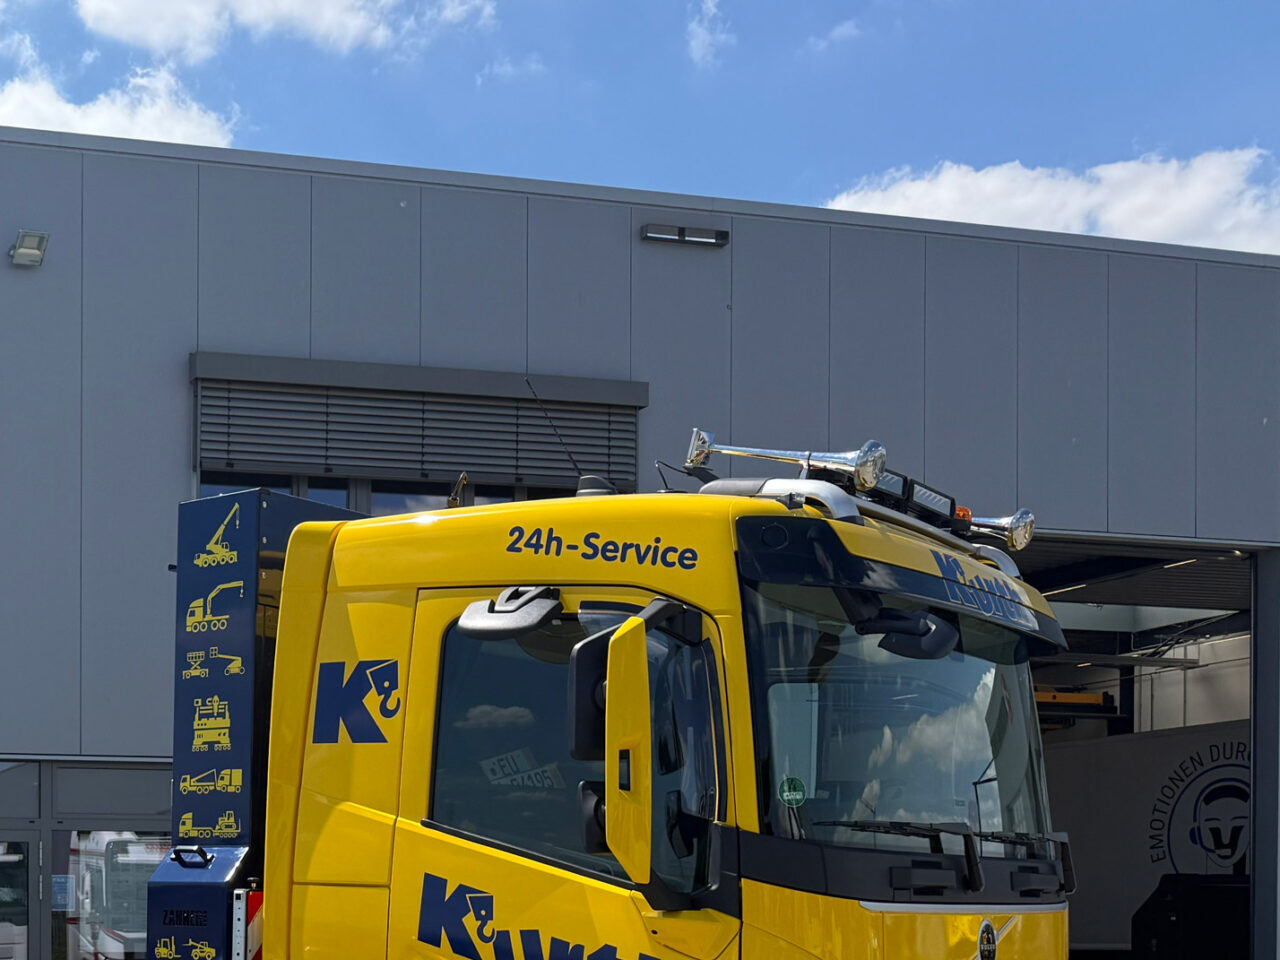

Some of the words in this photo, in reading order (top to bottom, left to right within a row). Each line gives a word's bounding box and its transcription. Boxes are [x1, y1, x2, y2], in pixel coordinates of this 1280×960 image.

[506, 526, 698, 569] 24h-Service
[1148, 752, 1205, 863] EMOTIONEN
[1209, 741, 1251, 762] DUR
